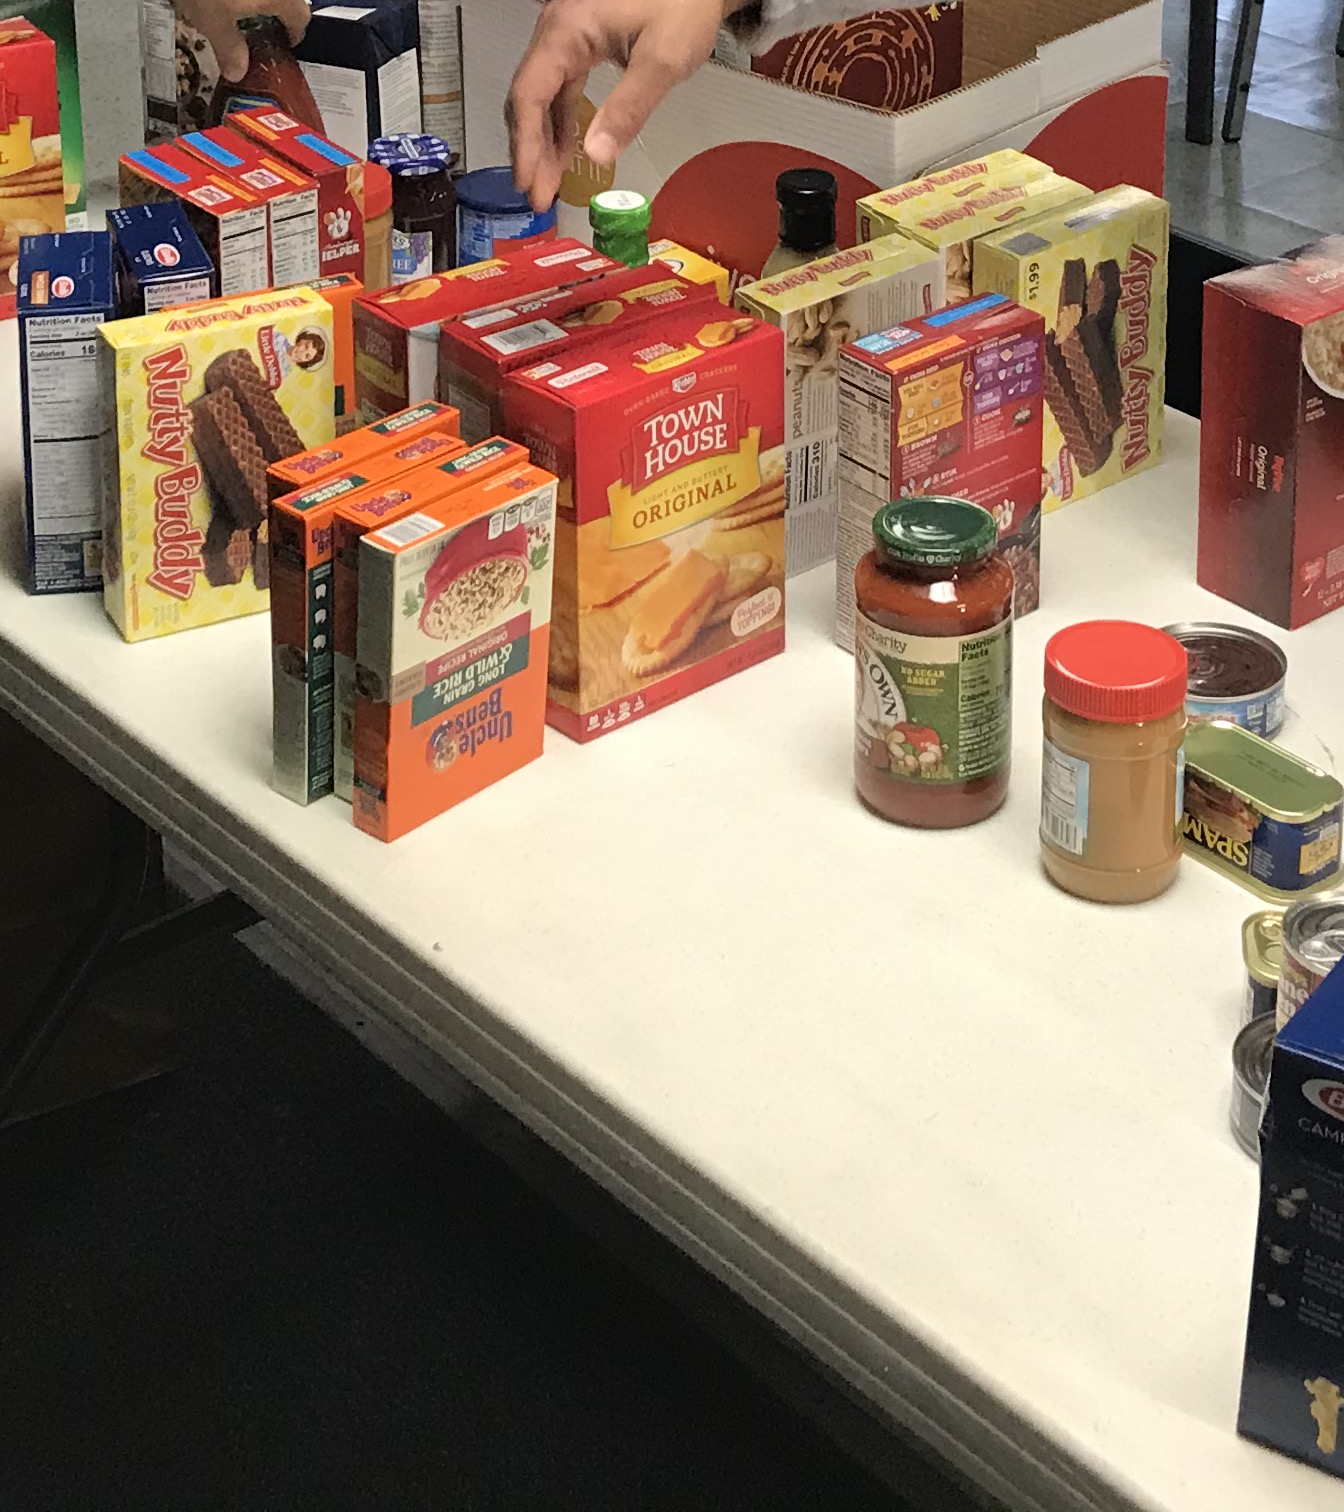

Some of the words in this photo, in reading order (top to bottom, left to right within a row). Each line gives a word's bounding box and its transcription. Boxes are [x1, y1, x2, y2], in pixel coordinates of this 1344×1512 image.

[879, 178, 936, 206] Nutty
[928, 162, 989, 188] Buddy
[918, 205, 976, 231] Nutty
[392, 256, 412, 271] REE
[758, 267, 820, 297] Nutty
[810, 249, 875, 277] Buddy
[146, 284, 183, 295] Nutrition
[184, 280, 208, 290] Facts
[1028, 262, 1040, 301] $1.99
[1118, 243, 1158, 369] Buddy
[29, 316, 72, 327] Nutrition
[73, 314, 102, 324] Facts
[30, 349, 66, 358] Calories
[81, 344, 96, 356] 18
[260, 329, 273, 355] Little
[699, 364, 738, 380] CRACKERS
[870, 368, 891, 383] Facts
[141, 342, 194, 470] Nutty
[623, 400, 644, 416] OVEN
[645, 388, 670, 405] BAKED
[792, 377, 804, 439] peanuts
[643, 392, 725, 448] TOWN
[1120, 365, 1155, 475] Nutty
[644, 422, 728, 481] HOUSE
[811, 441, 821, 465] 310
[1256, 445, 1269, 491] Original
[643, 489, 670, 506] LIGHT
[671, 481, 690, 494] AND
[690, 465, 729, 486] BUTTERY
[632, 474, 738, 529] ORIGINAL
[146, 461, 206, 602] Buddy
[467, 631, 508, 658] ORIGINAL
[865, 623, 908, 654] Charity
[437, 650, 467, 676] RECIPE
[961, 648, 990, 662] Facts
[477, 661, 506, 687] LONG
[900, 666, 914, 678] NO
[914, 668, 946, 679] SUGAR
[906, 675, 937, 687] ADDED
[432, 674, 463, 700] RICE
[442, 679, 476, 705] GRAIN
[869, 663, 899, 722] OWN
[960, 689, 991, 703] Calories
[459, 710, 514, 757] Uncle
[1183, 811, 1250, 868] SPAM
